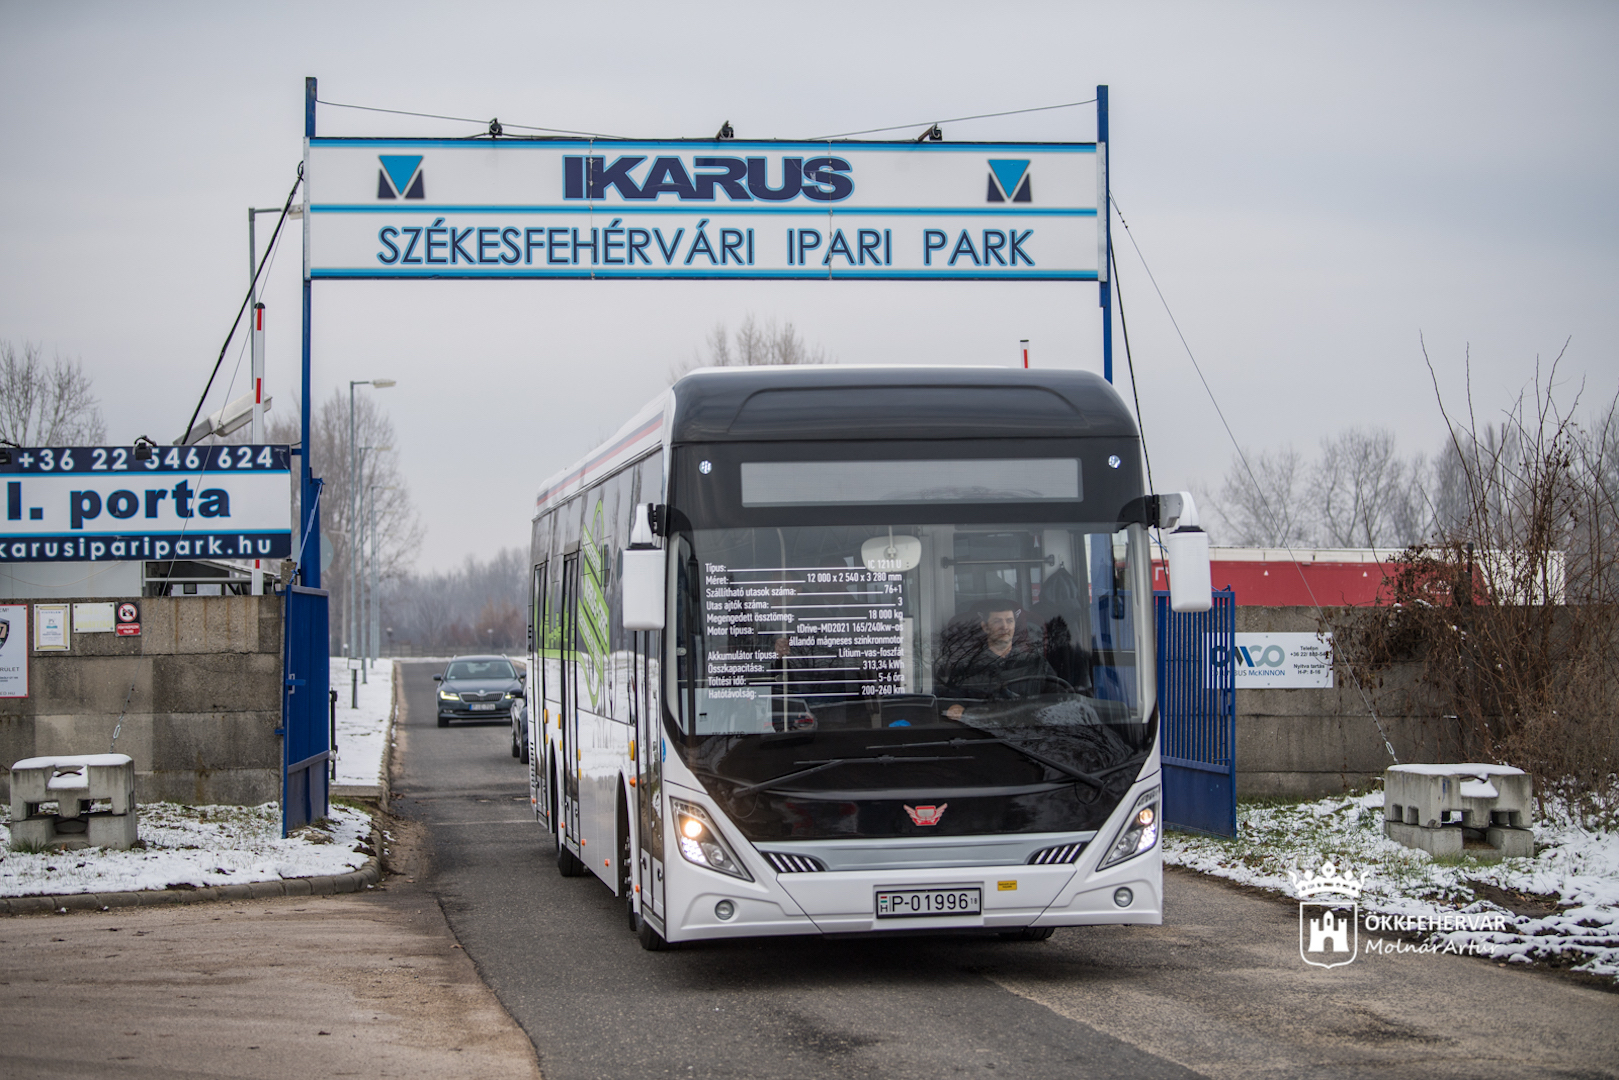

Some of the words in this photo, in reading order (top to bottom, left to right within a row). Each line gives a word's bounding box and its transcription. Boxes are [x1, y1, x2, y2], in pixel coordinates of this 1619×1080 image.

[562, 155, 855, 203] IKARUS
[377, 217, 755, 265] SZÉKESFEHÉRVÁRI
[787, 228, 892, 266] IPARI
[923, 229, 1036, 267] PARK
[18, 448, 75, 471] +36
[91, 448, 128, 470] 22
[144, 446, 200, 470] 546
[217, 446, 273, 469] 624
[70, 479, 231, 530] porta
[705, 562, 726, 574] Típus:
[877, 559, 895, 569] 1211
[895, 559, 902, 568] U
[705, 575, 729, 585] Méret:
[807, 573, 816, 583] 12
[817, 572, 831, 583] 000
[838, 572, 844, 582] 2
[845, 572, 859, 582] 540
[866, 572, 871, 581] 3
[873, 571, 887, 581] 280
[887, 573, 902, 581] mm
[745, 586, 770, 597] utasok
[771, 587, 797, 596] száma:
[884, 584, 902, 593] 76+1
[706, 601, 723, 611] Utas
[724, 599, 743, 612] ajtók
[744, 600, 770, 609] száma:
[897, 596, 903, 606] 3
[706, 612, 753, 625] Megengedett
[754, 612, 795, 623] össztömeg:
[869, 610, 878, 619] 18
[879, 609, 893, 619] 000
[894, 609, 904, 621] kg
[707, 626, 728, 636] Motor
[730, 625, 755, 637] típusa:
[788, 636, 816, 647] állandó
[816, 635, 852, 647] mágneses
[853, 635, 904, 645] szinkronmotor
[707, 650, 753, 661] Akkumulátor
[754, 649, 779, 661] típusa:
[708, 663, 764, 674] Összkapacitása:
[888, 660, 905, 669] kWh
[878, 672, 892, 682] 5-6
[892, 672, 905, 681] óra
[708, 688, 757, 700] Hatótávolság:
[861, 685, 892, 695] 200-260
[893, 685, 906, 694] km
[892, 893, 968, 912] P-01996
